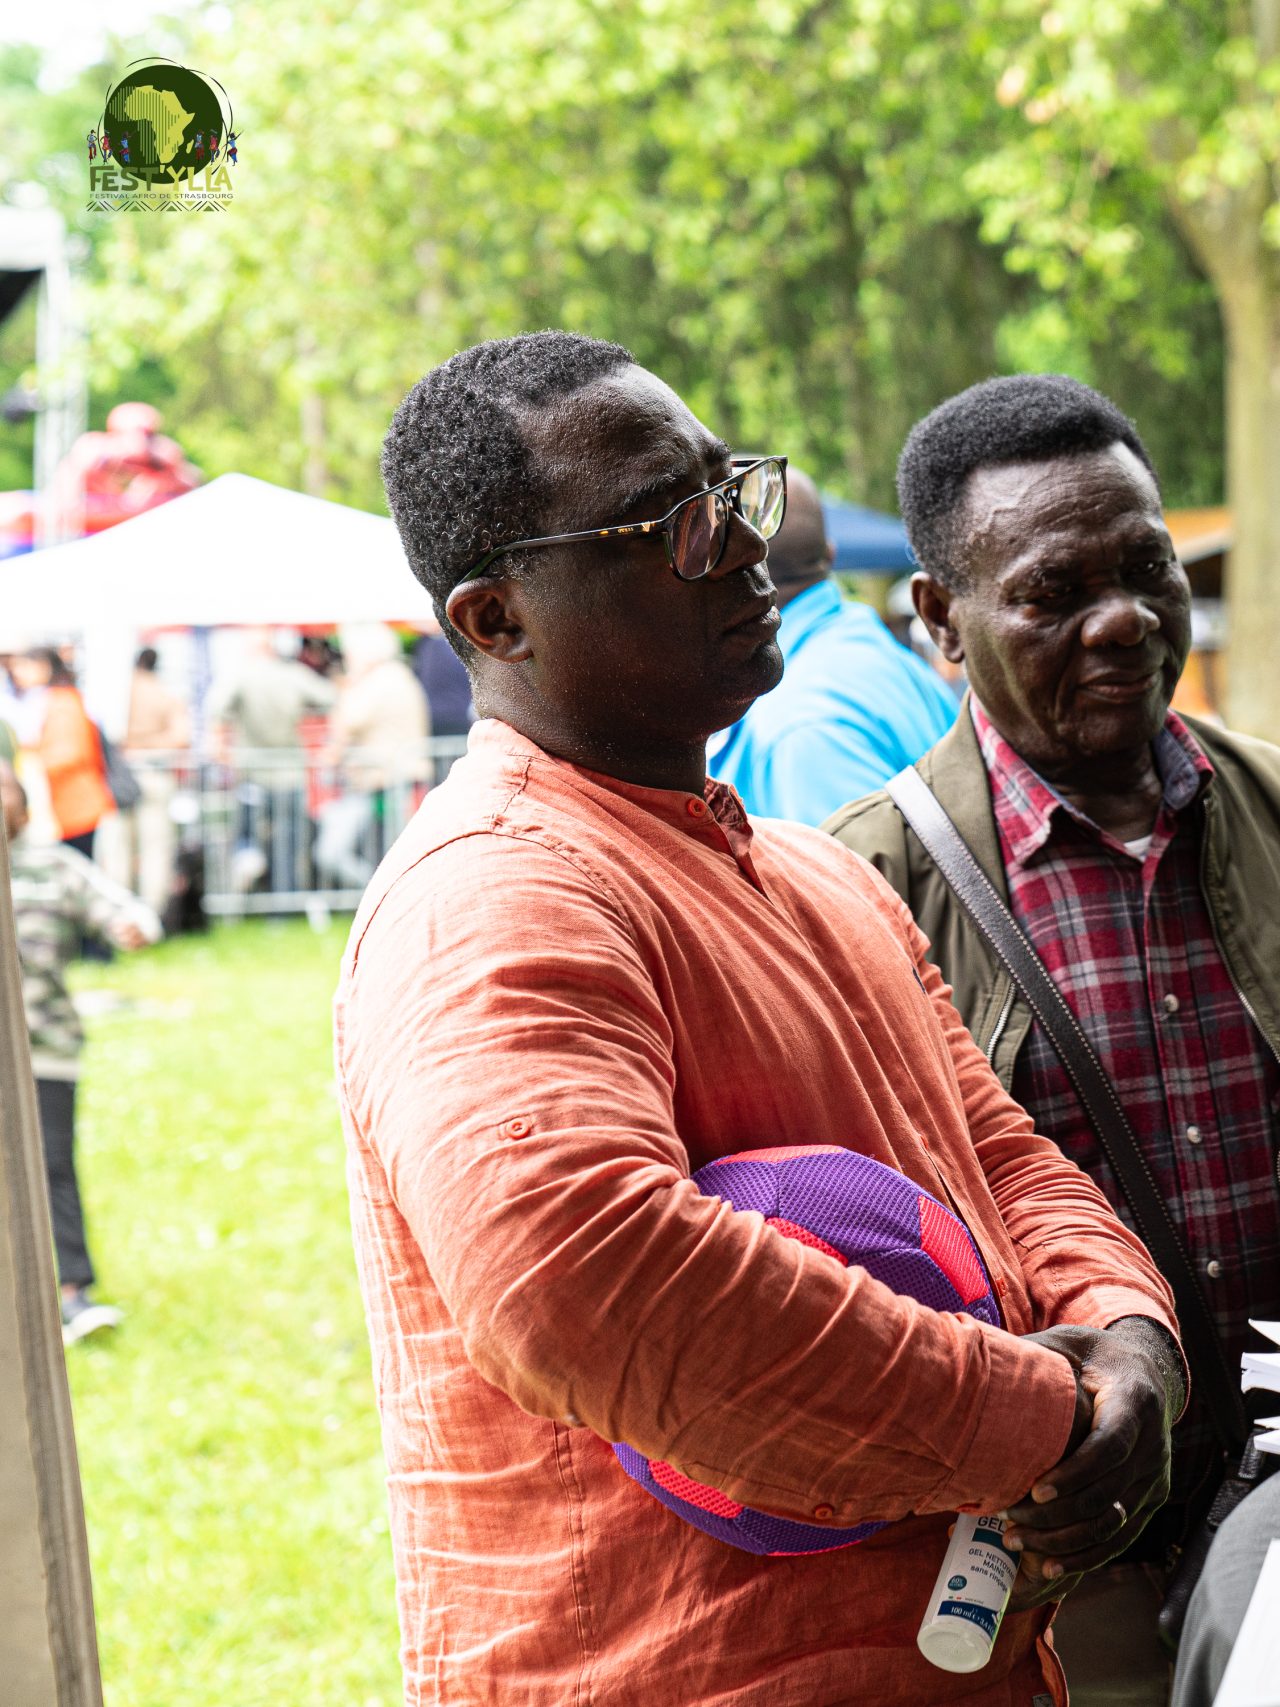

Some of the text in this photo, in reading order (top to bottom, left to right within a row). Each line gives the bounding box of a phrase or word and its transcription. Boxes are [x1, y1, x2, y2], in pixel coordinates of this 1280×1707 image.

[977, 1515, 1006, 1534] GEL
[968, 1548, 984, 1558] GEL
[970, 1566, 989, 1576] sans
[982, 1559, 1005, 1578] MAINS
